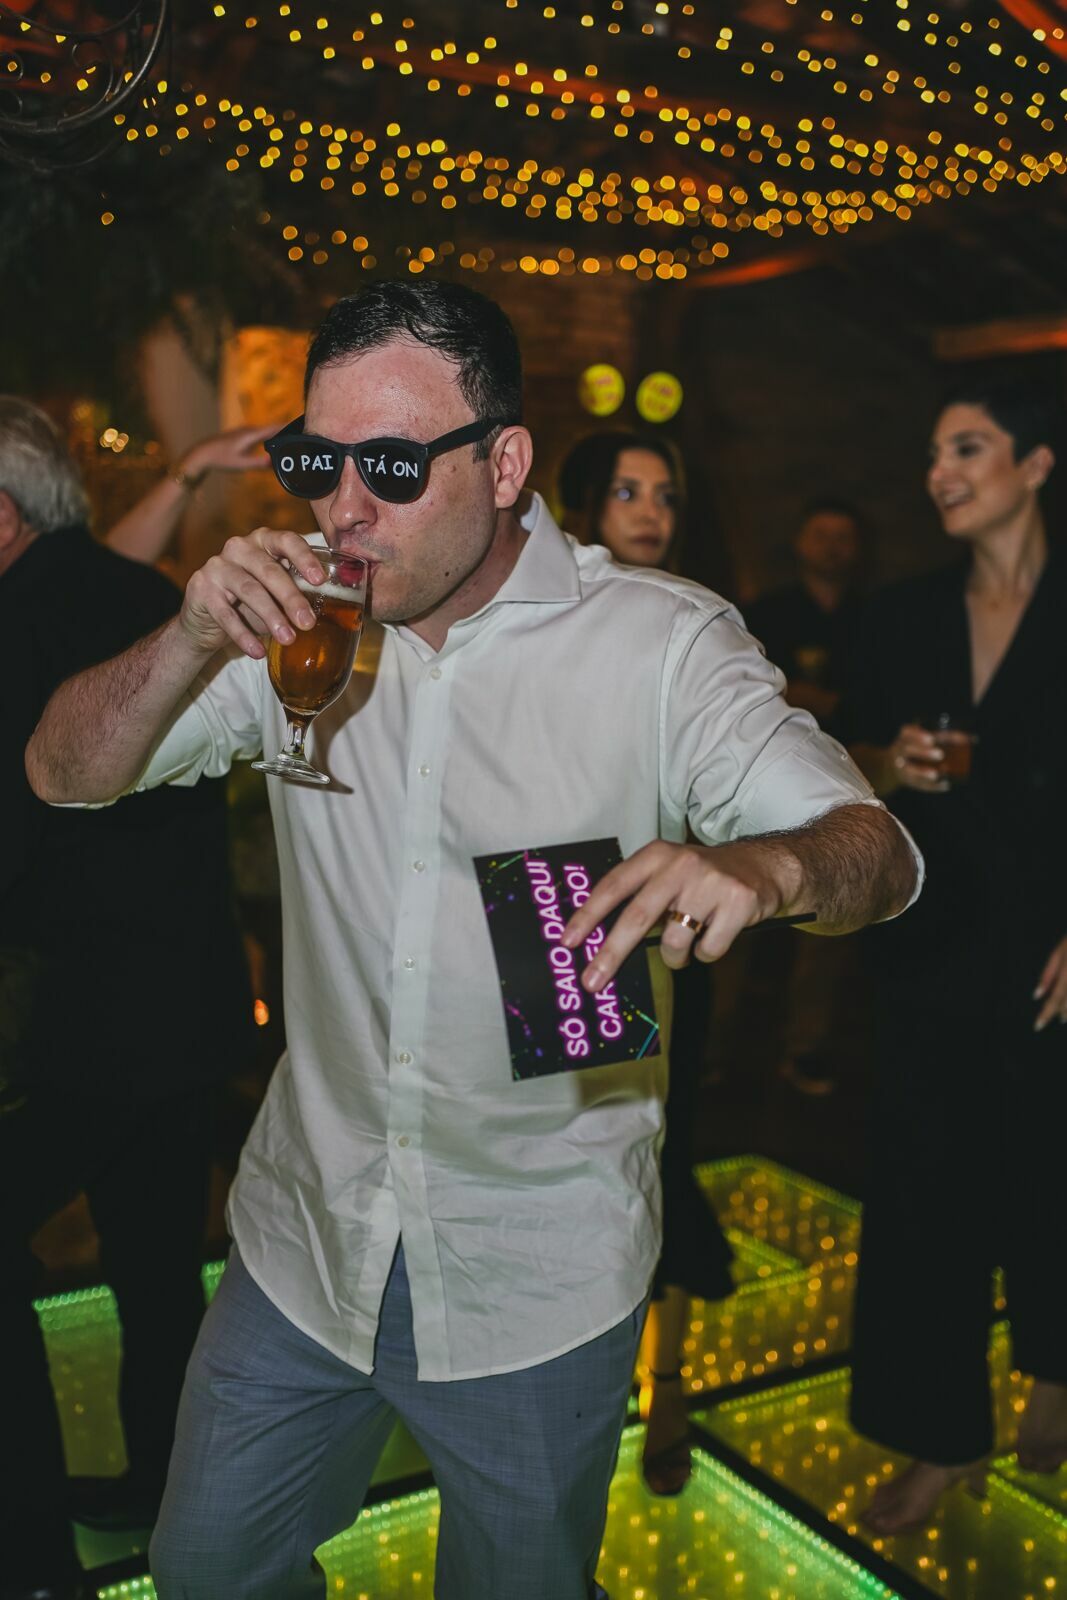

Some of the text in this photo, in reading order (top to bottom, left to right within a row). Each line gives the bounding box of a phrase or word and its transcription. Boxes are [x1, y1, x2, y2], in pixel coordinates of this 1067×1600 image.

[281, 454, 419, 478] O PAI TÁ ON
[525, 861, 589, 1056] SÓ SAIO DAQUI
[563, 865, 622, 1038] CARGDO!
